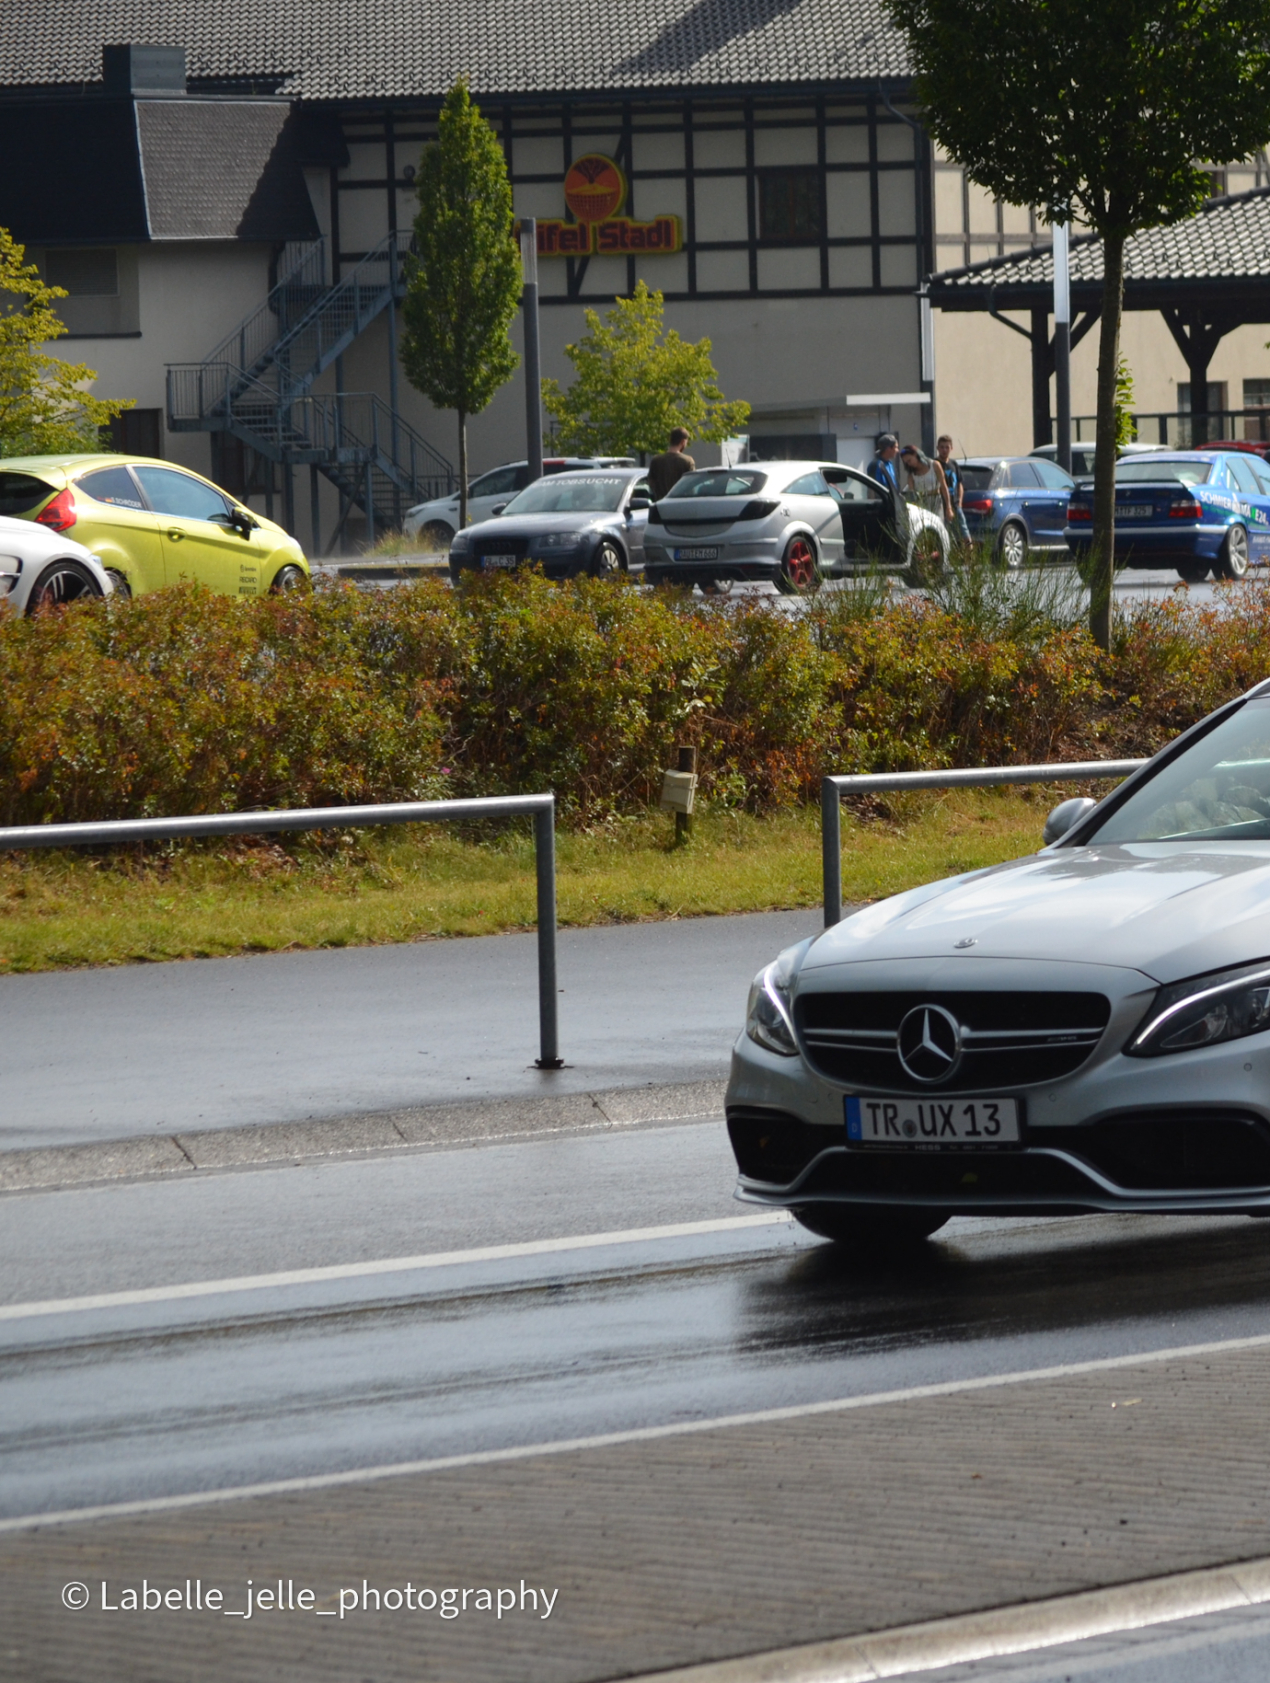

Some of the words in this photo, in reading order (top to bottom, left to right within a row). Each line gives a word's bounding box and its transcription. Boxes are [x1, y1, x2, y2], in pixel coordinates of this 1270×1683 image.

[516, 220, 588, 252] ifel
[598, 219, 674, 250] Stadl
[865, 1103, 901, 1137] TR
[917, 1104, 958, 1137] UX
[963, 1103, 1001, 1137] 13
